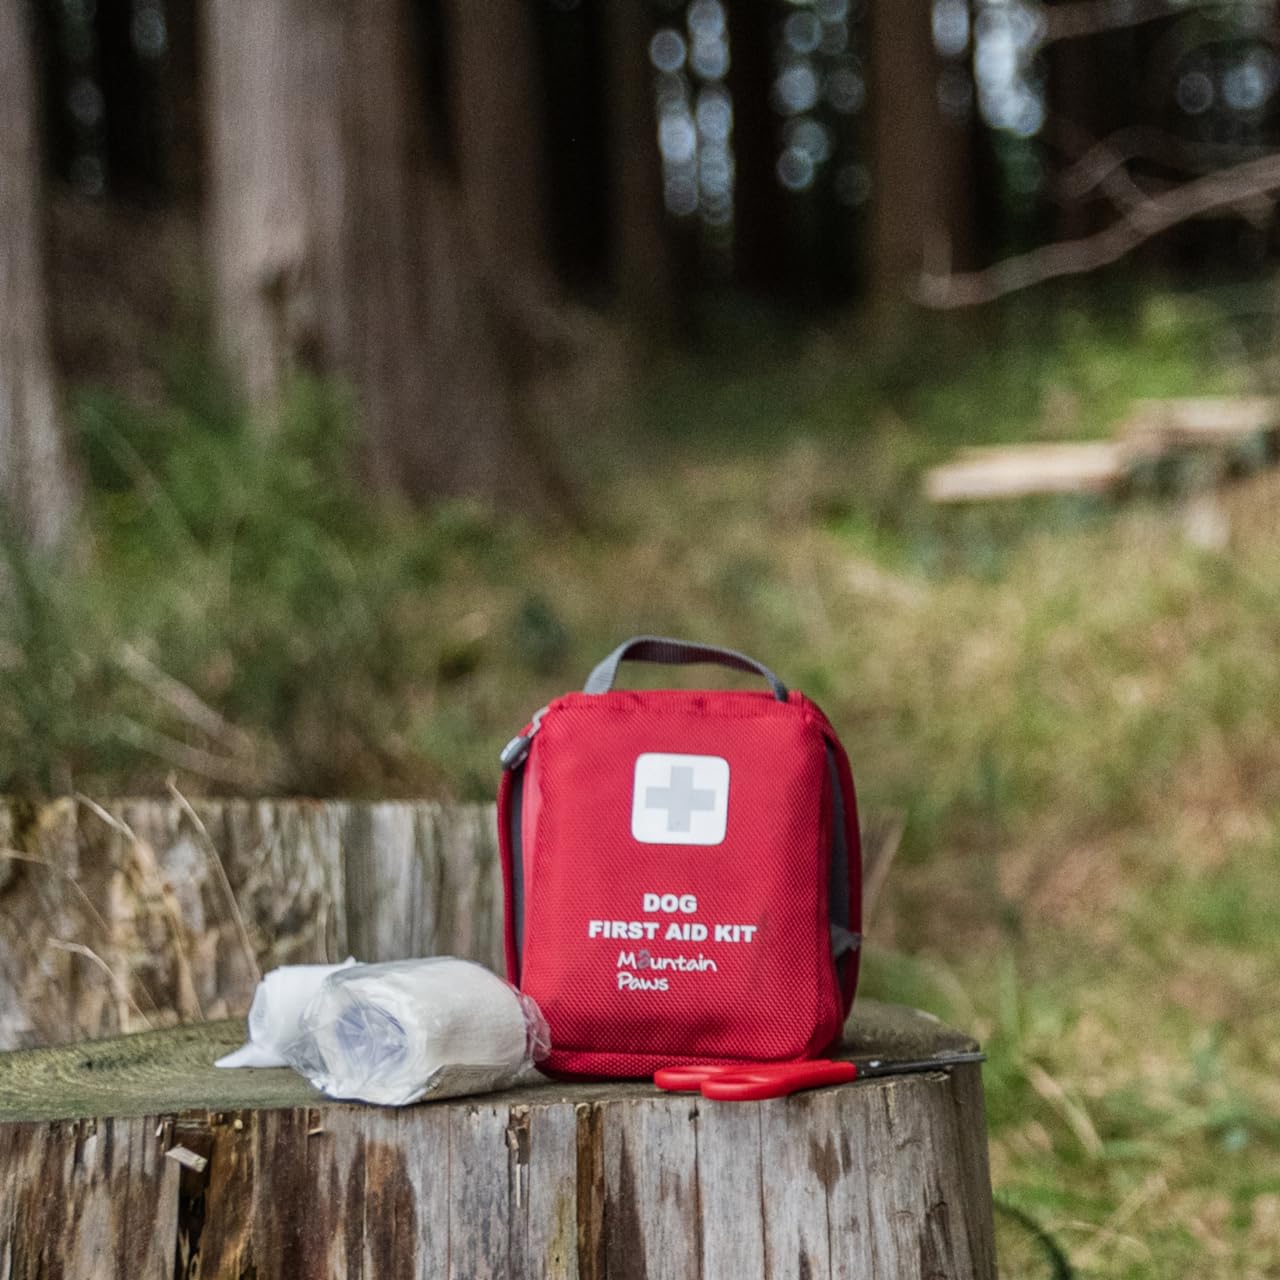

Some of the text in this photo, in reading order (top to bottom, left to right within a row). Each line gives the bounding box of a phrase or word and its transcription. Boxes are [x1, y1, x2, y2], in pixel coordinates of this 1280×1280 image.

[643, 893, 697, 913] DOG
[588, 920, 757, 943] FIRST AID KIT
[617, 971, 669, 991] Paws
